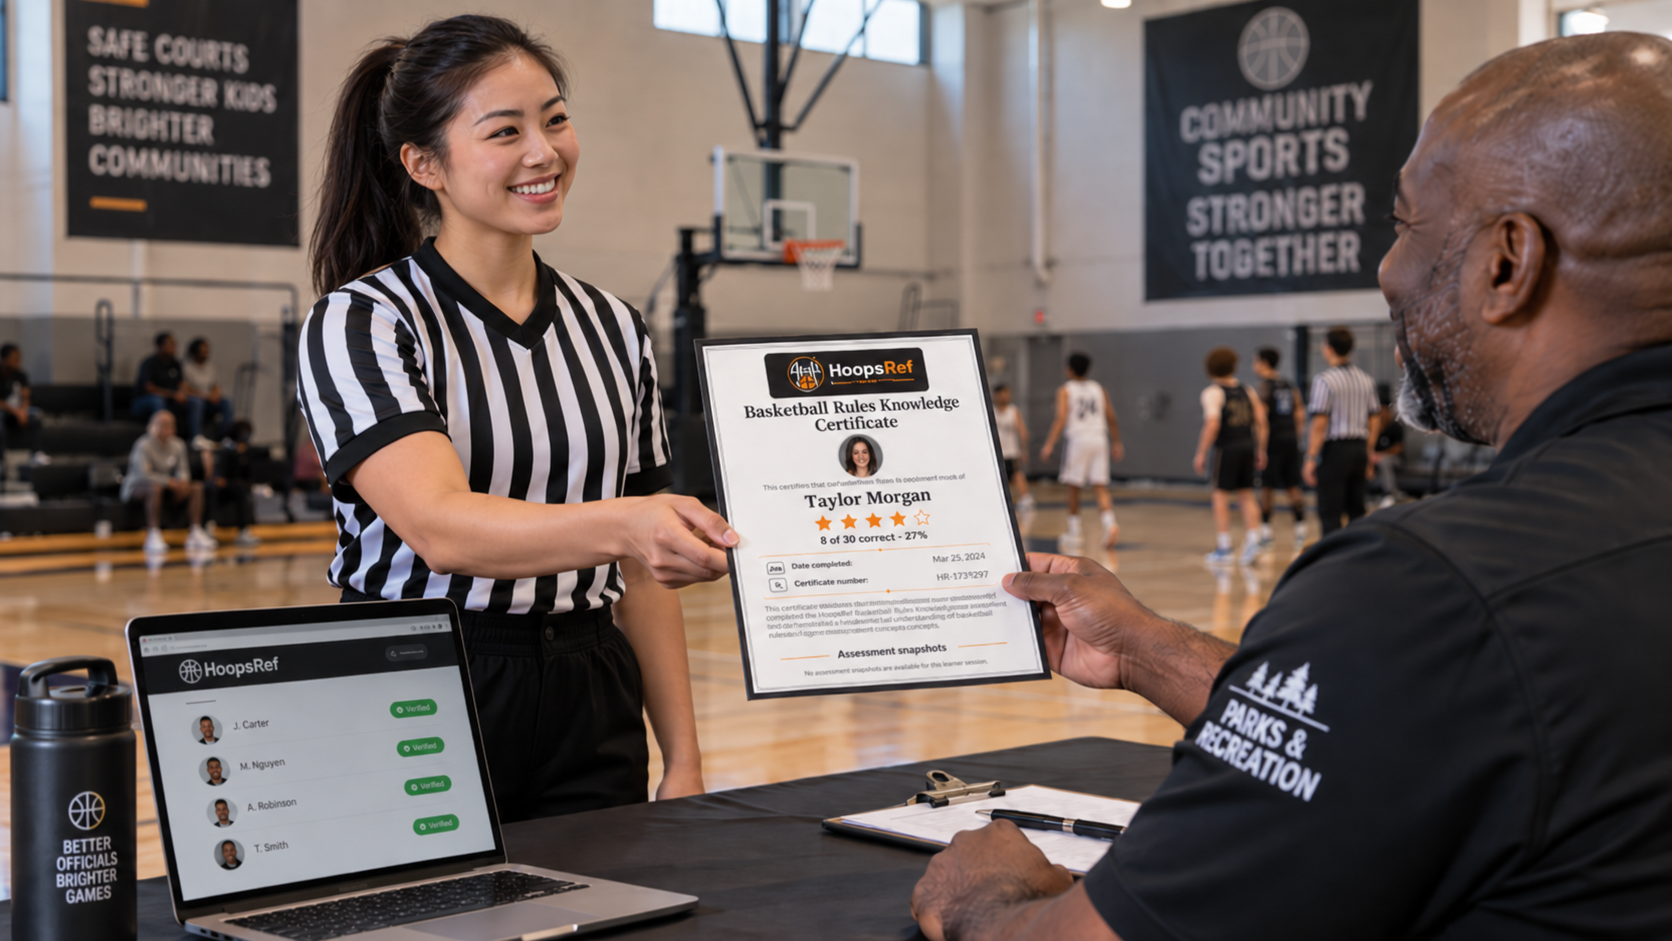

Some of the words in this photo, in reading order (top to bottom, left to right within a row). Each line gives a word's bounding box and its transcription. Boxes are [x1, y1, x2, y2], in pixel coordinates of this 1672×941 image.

[87, 25, 149, 63] SAFE
[154, 33, 249, 74] COURTS
[88, 65, 218, 108] STRONGER
[224, 80, 277, 114] KIDS
[1179, 79, 1374, 144] COMMUNITY
[88, 104, 214, 146] BRIGHTER
[1197, 126, 1350, 185] SPORTS
[88, 143, 272, 188] COMMUNITIES
[1186, 181, 1366, 237] STRONGER
[1190, 230, 1361, 281] TOGETHER
[829, 360, 914, 379] HoopsRef
[743, 401, 828, 419] Basketball
[834, 399, 876, 414] Rules
[880, 396, 960, 412] Knowledge
[815, 416, 898, 432] Certificate
[811, 481, 826, 489] that
[804, 492, 861, 511] Taylor
[866, 490, 931, 508] Morgan
[820, 535, 827, 545] 8
[830, 534, 840, 544] of
[843, 533, 856, 544] 30
[858, 533, 896, 543] correct
[905, 530, 928, 540] 27%
[791, 562, 810, 570] Date
[811, 560, 853, 569] completed:
[932, 555, 949, 563] Mar
[964, 552, 986, 561] 2024
[794, 579, 835, 587] Certificate
[836, 577, 869, 585] number:
[838, 646, 895, 659] Assessment
[897, 643, 947, 657] snapshots
[204, 656, 280, 678] HoopsRef
[815, 667, 851, 676] assessment
[851, 665, 882, 675] snapshots
[894, 662, 920, 671] available
[930, 660, 941, 668] this
[405, 703, 431, 713] Verified
[233, 722, 241, 731] J.
[242, 718, 270, 730] Carter
[1219, 698, 1287, 749] PARKS
[1284, 728, 1308, 760] &
[412, 741, 438, 752] Verified
[239, 762, 251, 771] M.
[252, 757, 286, 771] Nguyen
[1194, 720, 1322, 802] RECREATION
[420, 779, 445, 790] Verified
[247, 803, 258, 812] A.
[258, 798, 298, 811] Robinson
[428, 818, 453, 830] Verified
[63, 836, 112, 855] BETTER
[254, 844, 264, 854] T.
[264, 840, 290, 853] Smith
[56, 851, 118, 872] OFFICIALS
[56, 868, 118, 889] BRIGHTER
[65, 885, 112, 904] GAMES
